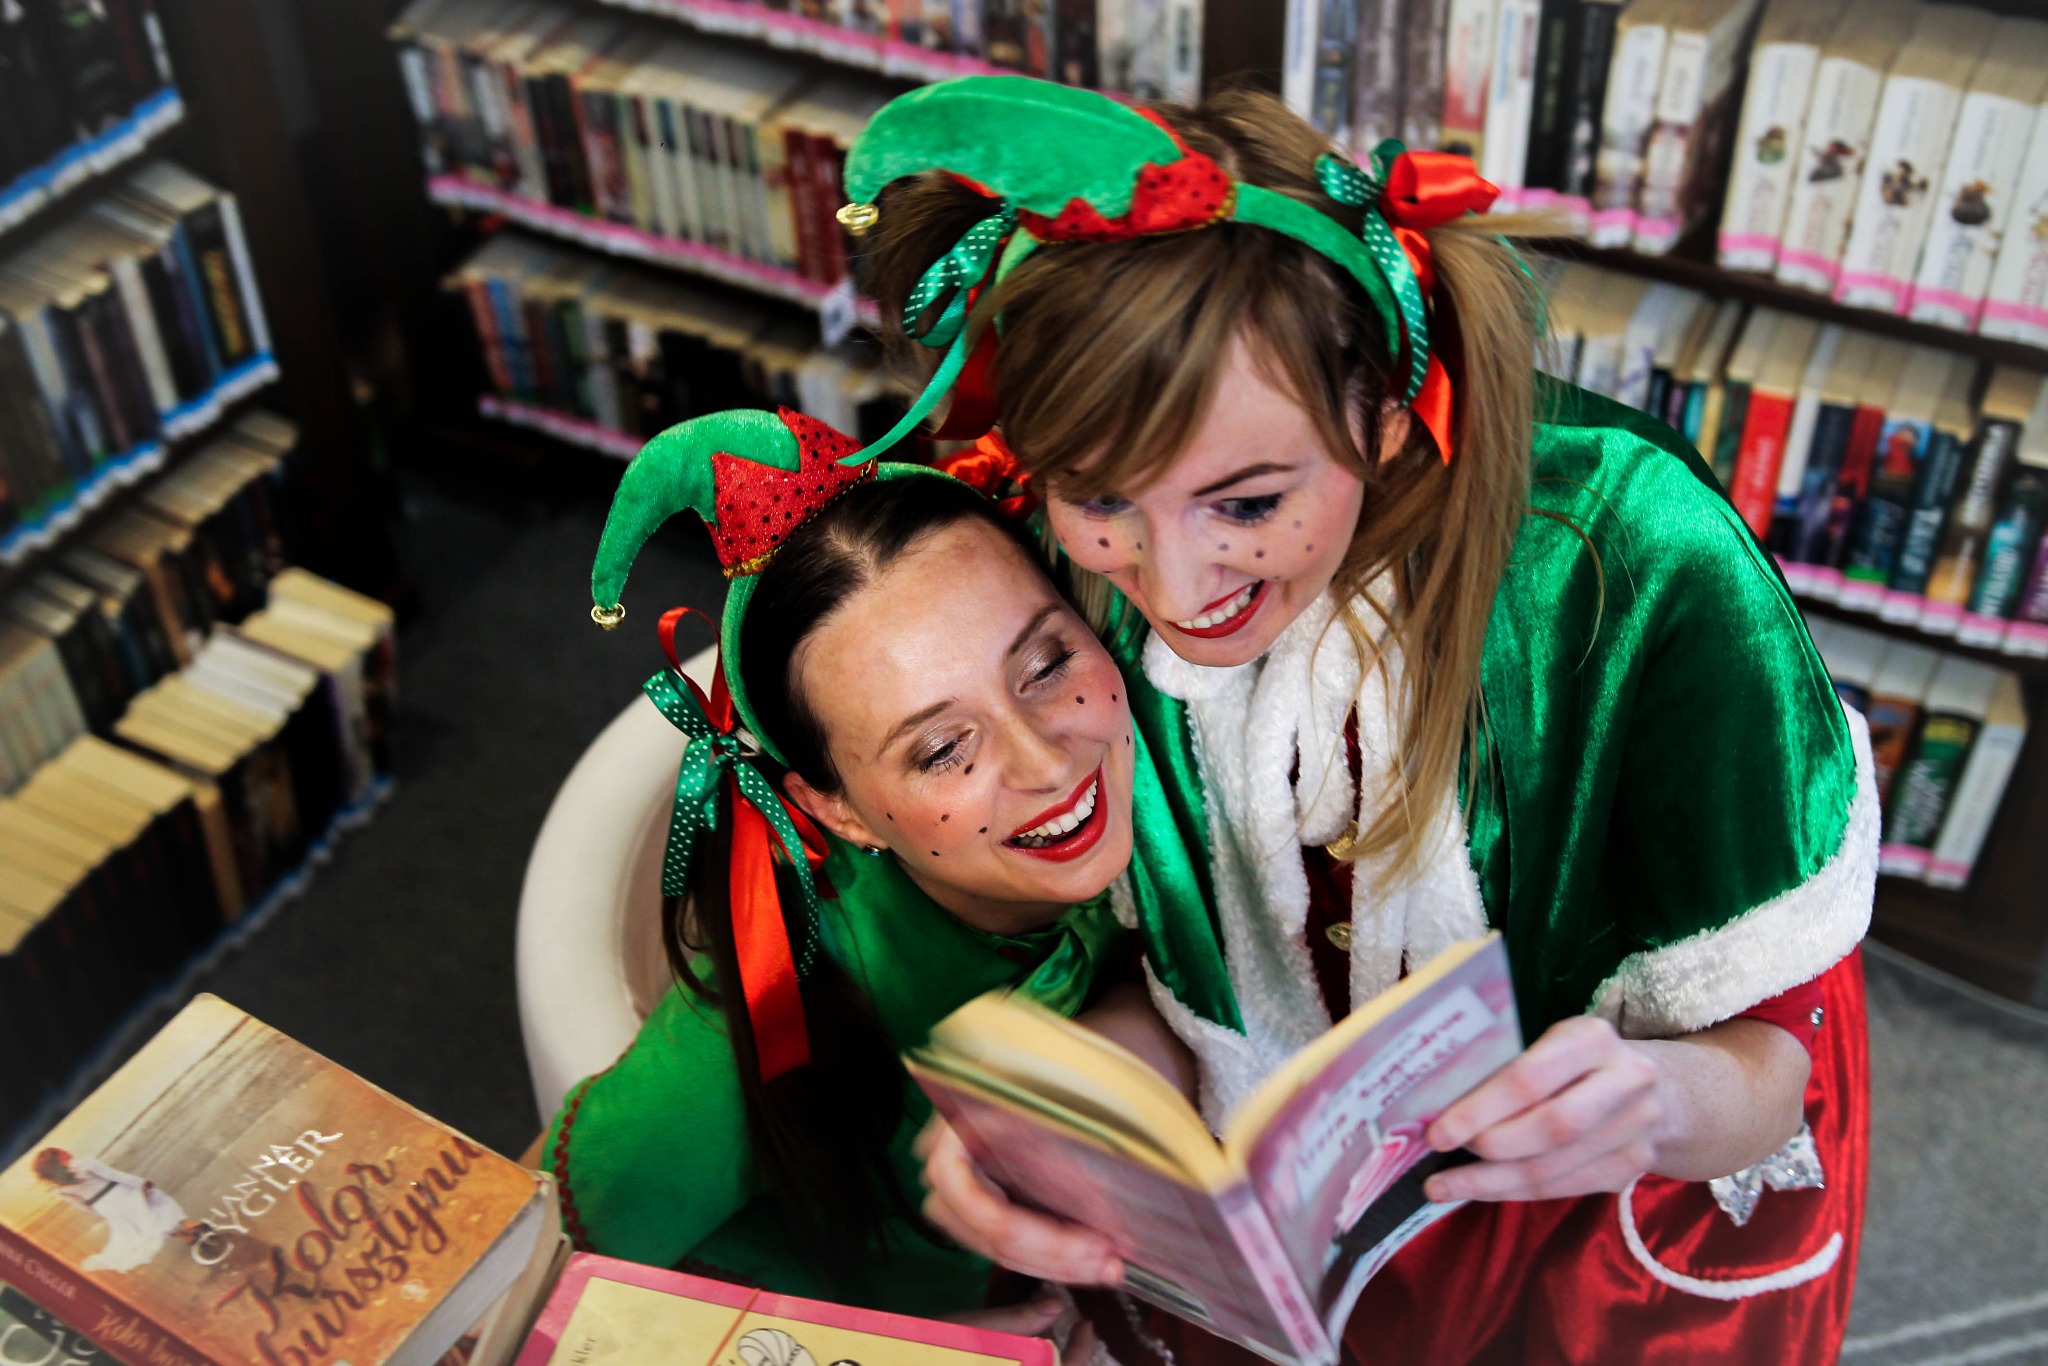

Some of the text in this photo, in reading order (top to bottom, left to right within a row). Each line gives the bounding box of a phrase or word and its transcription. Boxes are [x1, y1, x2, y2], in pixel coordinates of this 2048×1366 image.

[191, 1129, 344, 1265] CYGLER
[215, 1158, 396, 1337] Kolor
[255, 1136, 483, 1366] bursztynu
